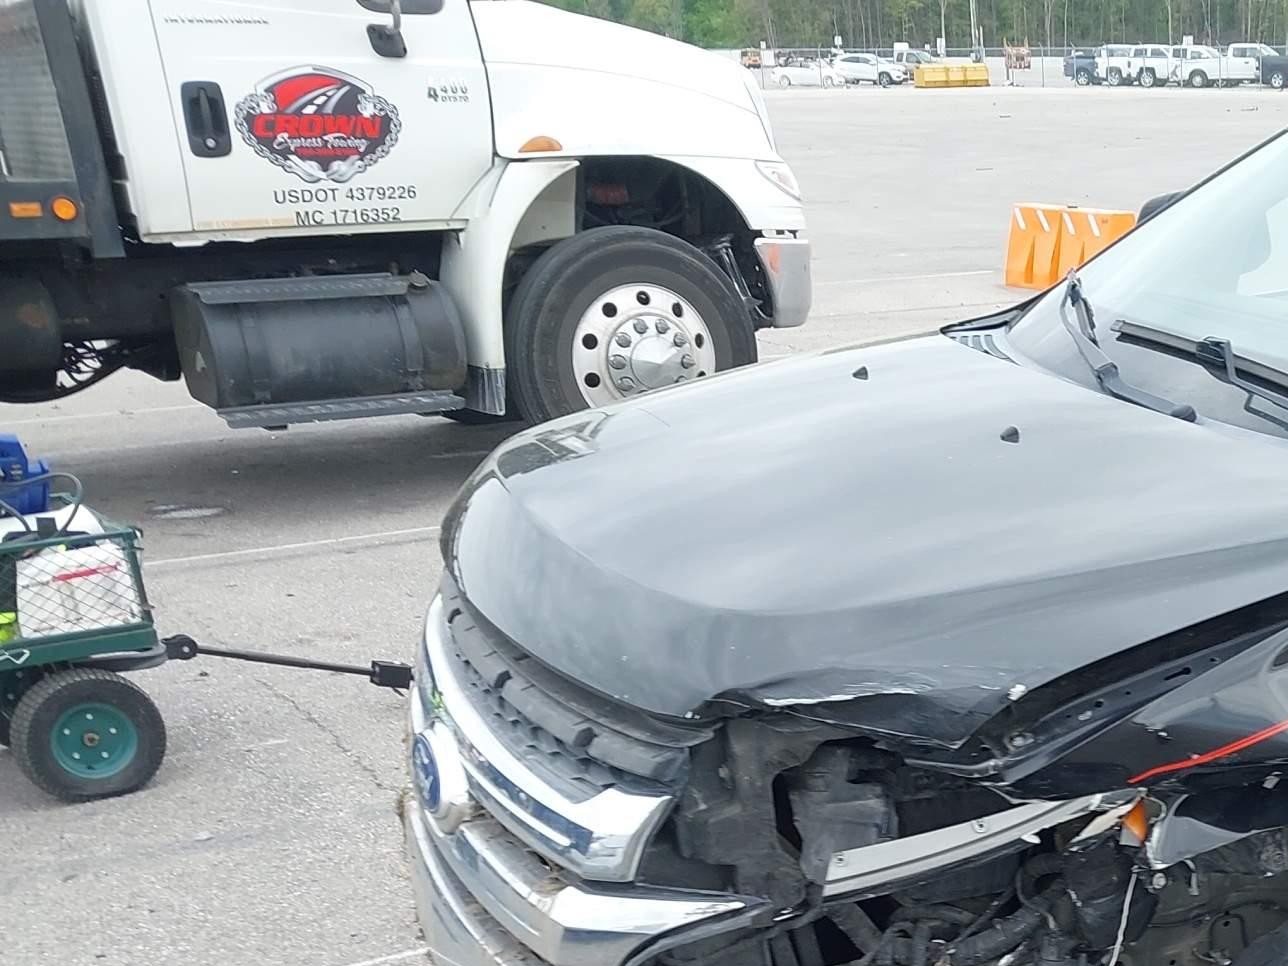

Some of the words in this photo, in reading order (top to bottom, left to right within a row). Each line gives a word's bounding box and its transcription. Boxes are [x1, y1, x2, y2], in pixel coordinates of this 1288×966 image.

[254, 113, 382, 138] CROWN
[273, 132, 323, 152] Express
[322, 133, 369, 153] Towing
[273, 188, 340, 205] USDOT
[345, 185, 417, 200] 4379226
[295, 210, 325, 226] MC
[331, 206, 401, 224] 1716352
